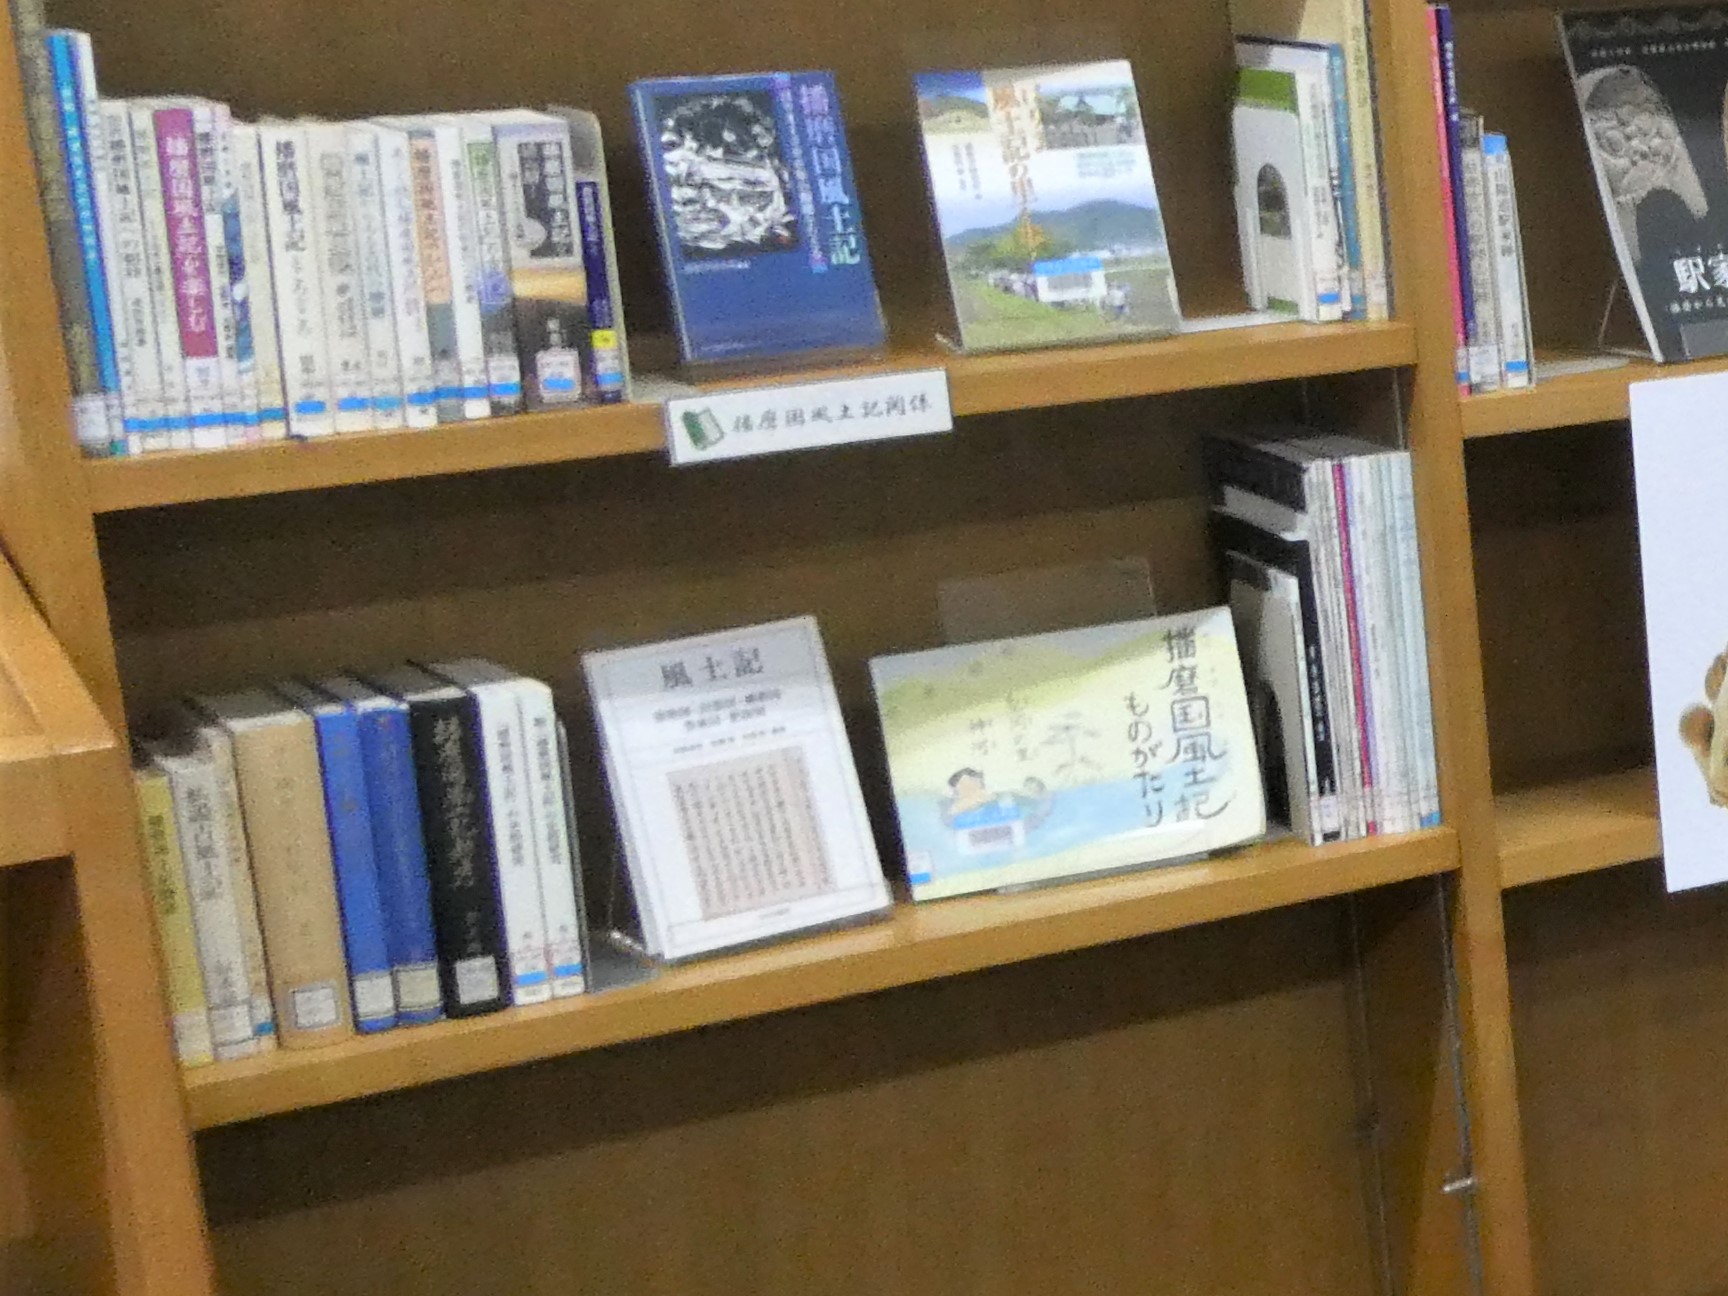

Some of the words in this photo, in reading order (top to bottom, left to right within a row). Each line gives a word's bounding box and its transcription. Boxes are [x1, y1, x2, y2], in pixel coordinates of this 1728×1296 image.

[660, 647, 765, 691] 風土記
[1158, 625, 1238, 823] 播磨国風土記
[1124, 691, 1165, 828] ものがたり
